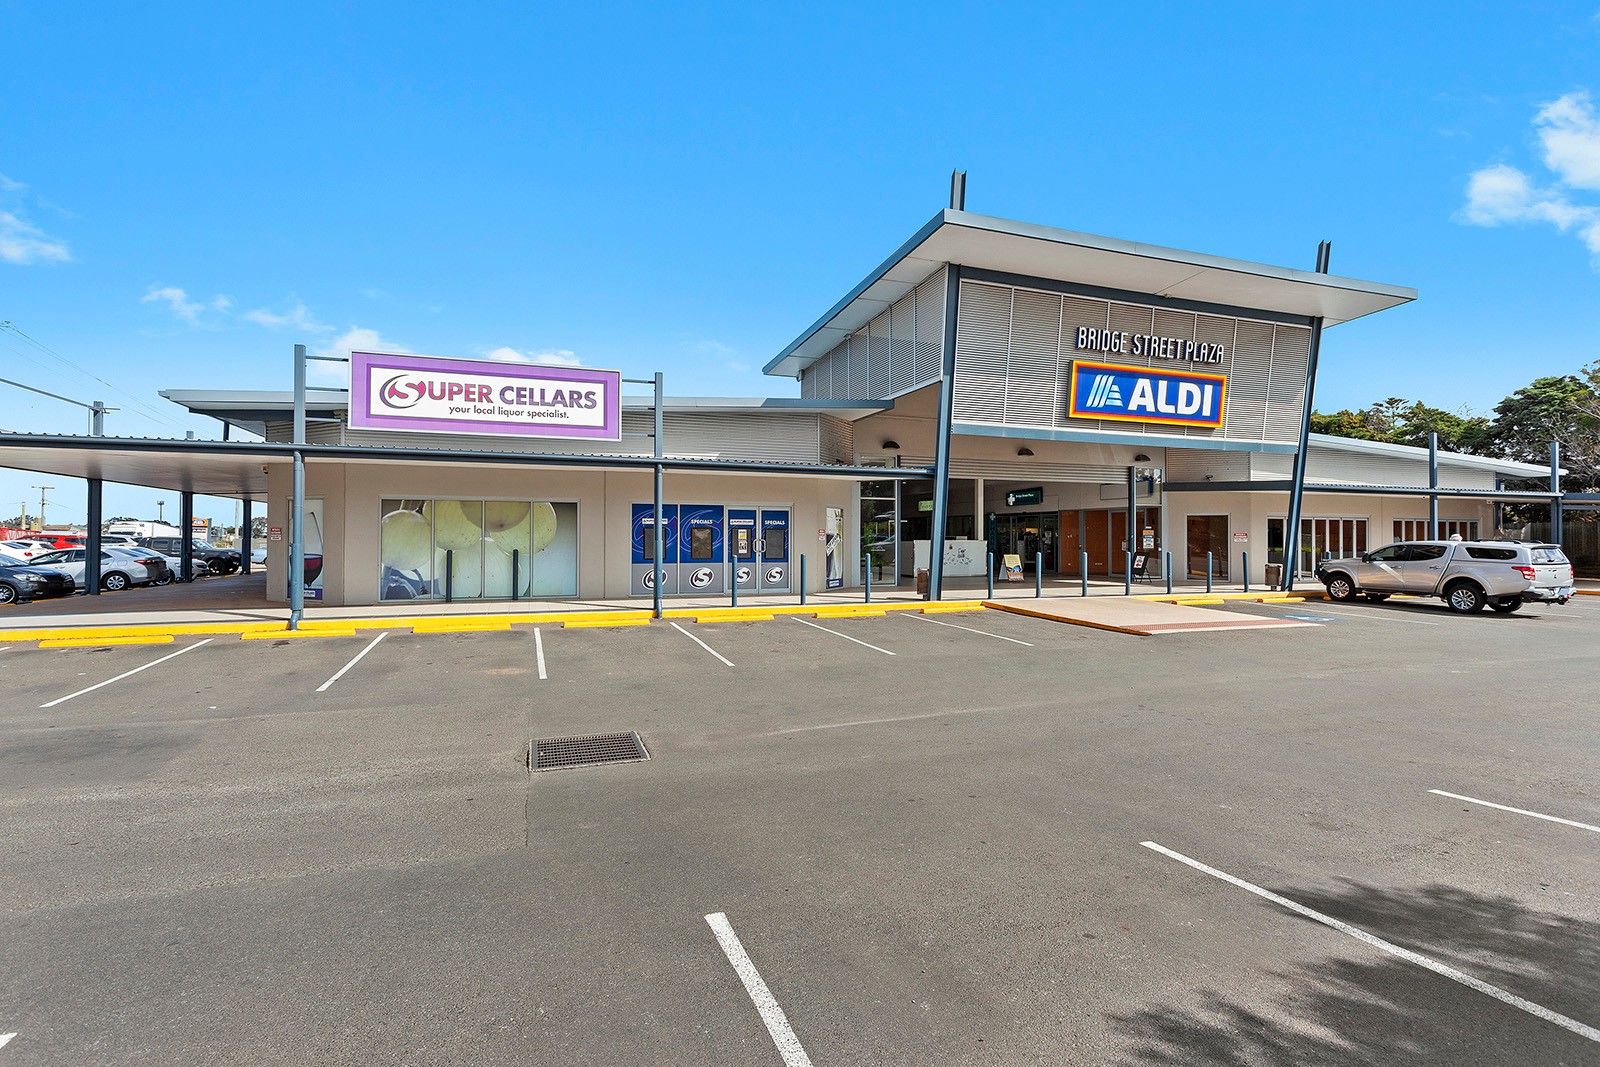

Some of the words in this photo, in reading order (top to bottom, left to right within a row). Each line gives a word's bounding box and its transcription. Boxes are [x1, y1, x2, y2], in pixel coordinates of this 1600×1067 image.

[1077, 327, 1129, 353] BRIDGE
[1132, 334, 1184, 359] STREET
[1185, 341, 1224, 363] PLAZA
[380, 374, 494, 408] SUPER
[500, 386, 597, 409] CELLARS
[1127, 377, 1214, 417] ALDI
[448, 405, 470, 415] your
[474, 405, 495, 415] local
[498, 407, 524, 418] liquor
[527, 409, 569, 420] specialist.
